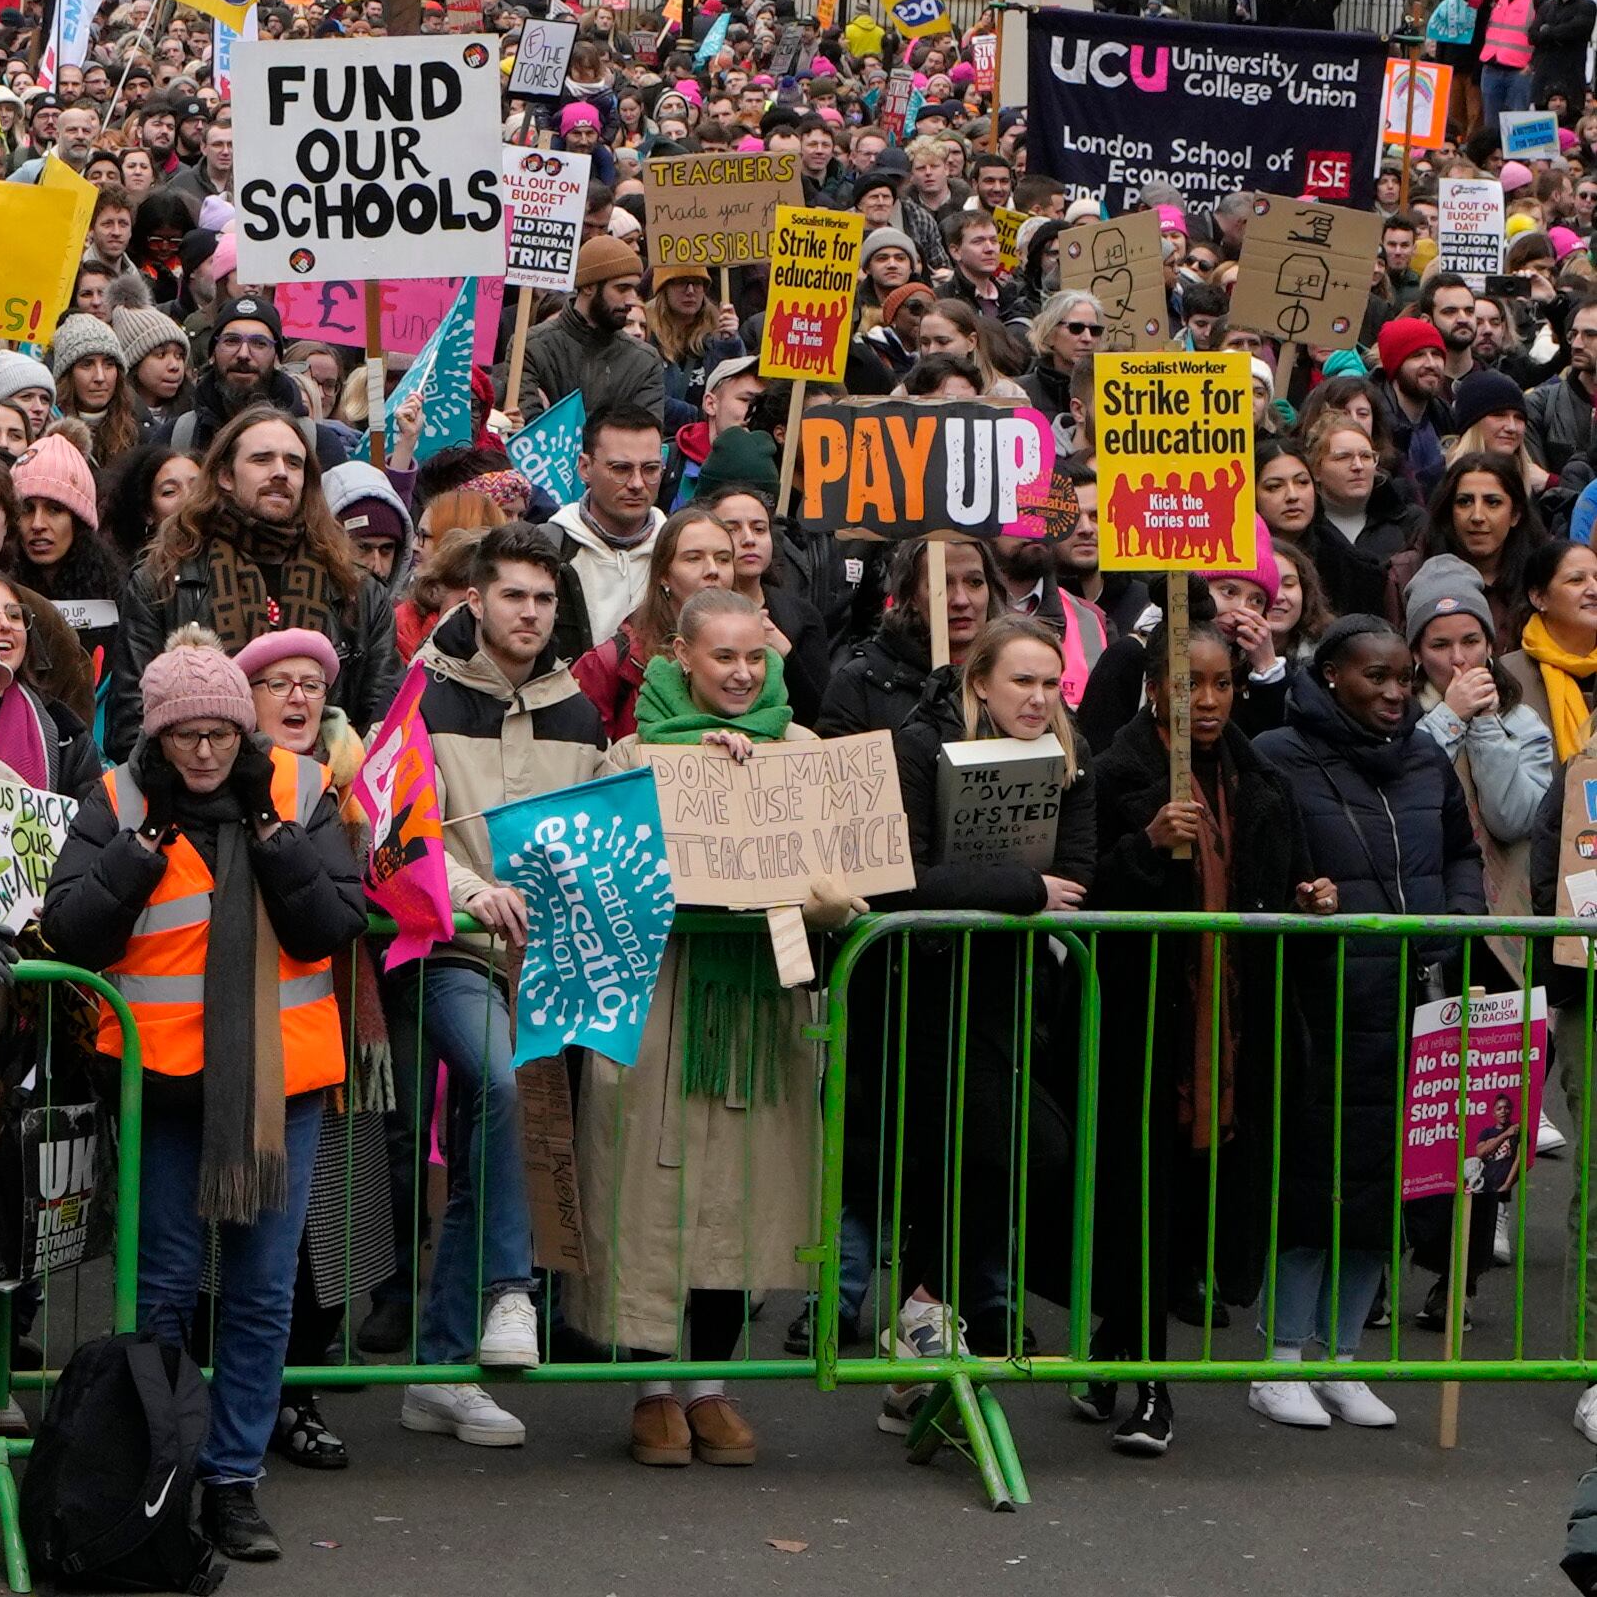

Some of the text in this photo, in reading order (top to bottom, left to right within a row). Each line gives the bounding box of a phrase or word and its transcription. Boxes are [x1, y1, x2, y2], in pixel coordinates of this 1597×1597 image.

[517, 62, 563, 88] TORIES
[1050, 35, 1359, 93] UCU University and
[267, 60, 462, 127] FUND
[1183, 73, 1357, 109] College Union
[295, 126, 433, 185] OUR
[1063, 125, 1294, 172] London School of
[650, 155, 796, 187] TEACHERS
[1108, 160, 1245, 192] Economics
[1307, 160, 1347, 188] LSE
[239, 169, 503, 242] SCHOOLS
[511, 190, 567, 205] BUDGET
[521, 204, 552, 217] DAY!
[1447, 212, 1489, 221] BUDGET
[527, 236, 573, 249] GENERAL
[778, 227, 858, 261] Strike for
[774, 260, 853, 292] education
[1441, 256, 1497, 272] STRIKE
[1103, 380, 1245, 416] Strike for
[1105, 419, 1246, 455] education
[801, 416, 1041, 526] PAY UP
[1017, 493, 1079, 513] education
[1149, 494, 1203, 510] Kick the
[1143, 512, 1210, 528] Tories out
[961, 770, 1000, 783] THE
[675, 776, 883, 826] ME USE MY
[663, 813, 904, 881] TEACHER VOICE
[534, 815, 630, 1034] education
[549, 894, 578, 982] union
[591, 863, 650, 980] national
[1481, 1008, 1519, 1022] RACISM
[39, 1135, 98, 1200] UK
